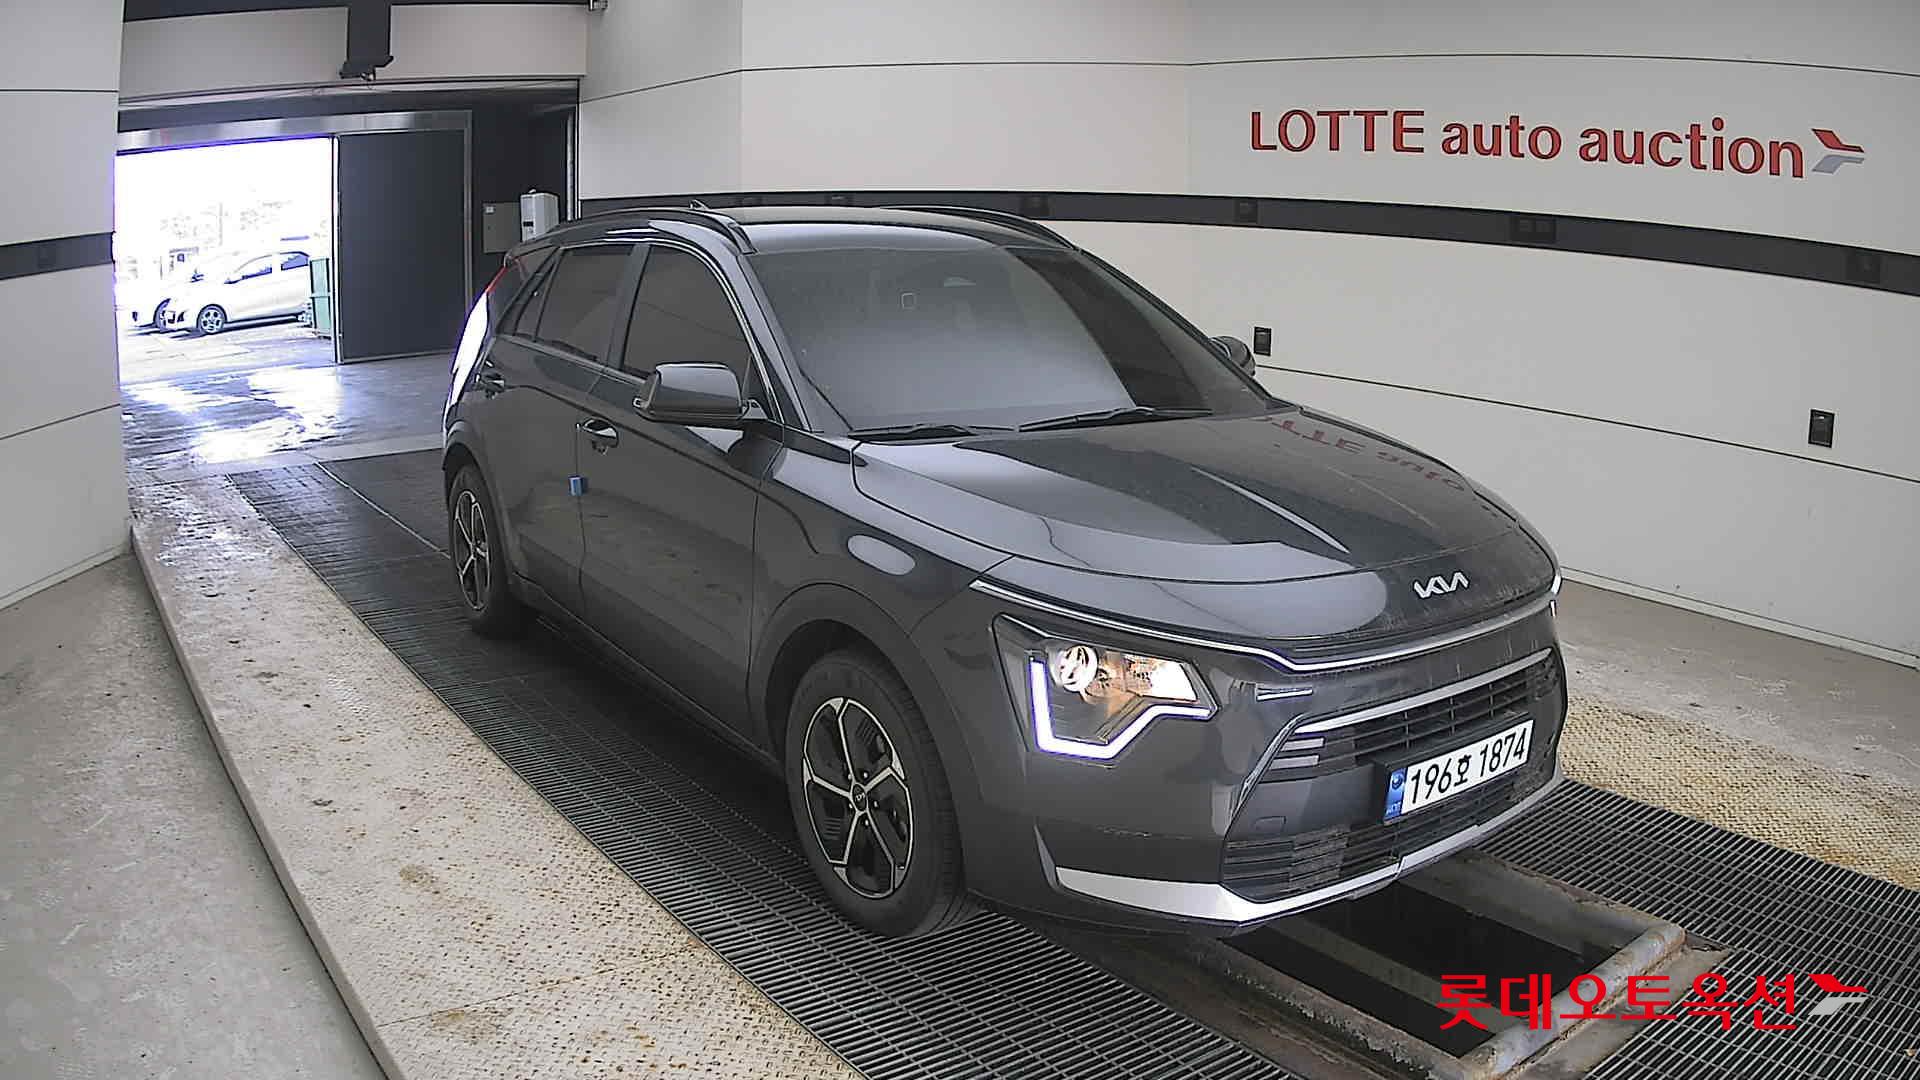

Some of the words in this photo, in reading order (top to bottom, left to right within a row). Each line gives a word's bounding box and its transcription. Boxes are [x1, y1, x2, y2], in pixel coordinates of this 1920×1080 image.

[1250, 109, 1426, 152] LOTTE
[1441, 114, 1563, 160] auto
[1577, 116, 1805, 179] auction
[1413, 571, 1470, 599] KIA
[1411, 754, 1472, 804] 196호
[1479, 727, 1527, 778] 1874
